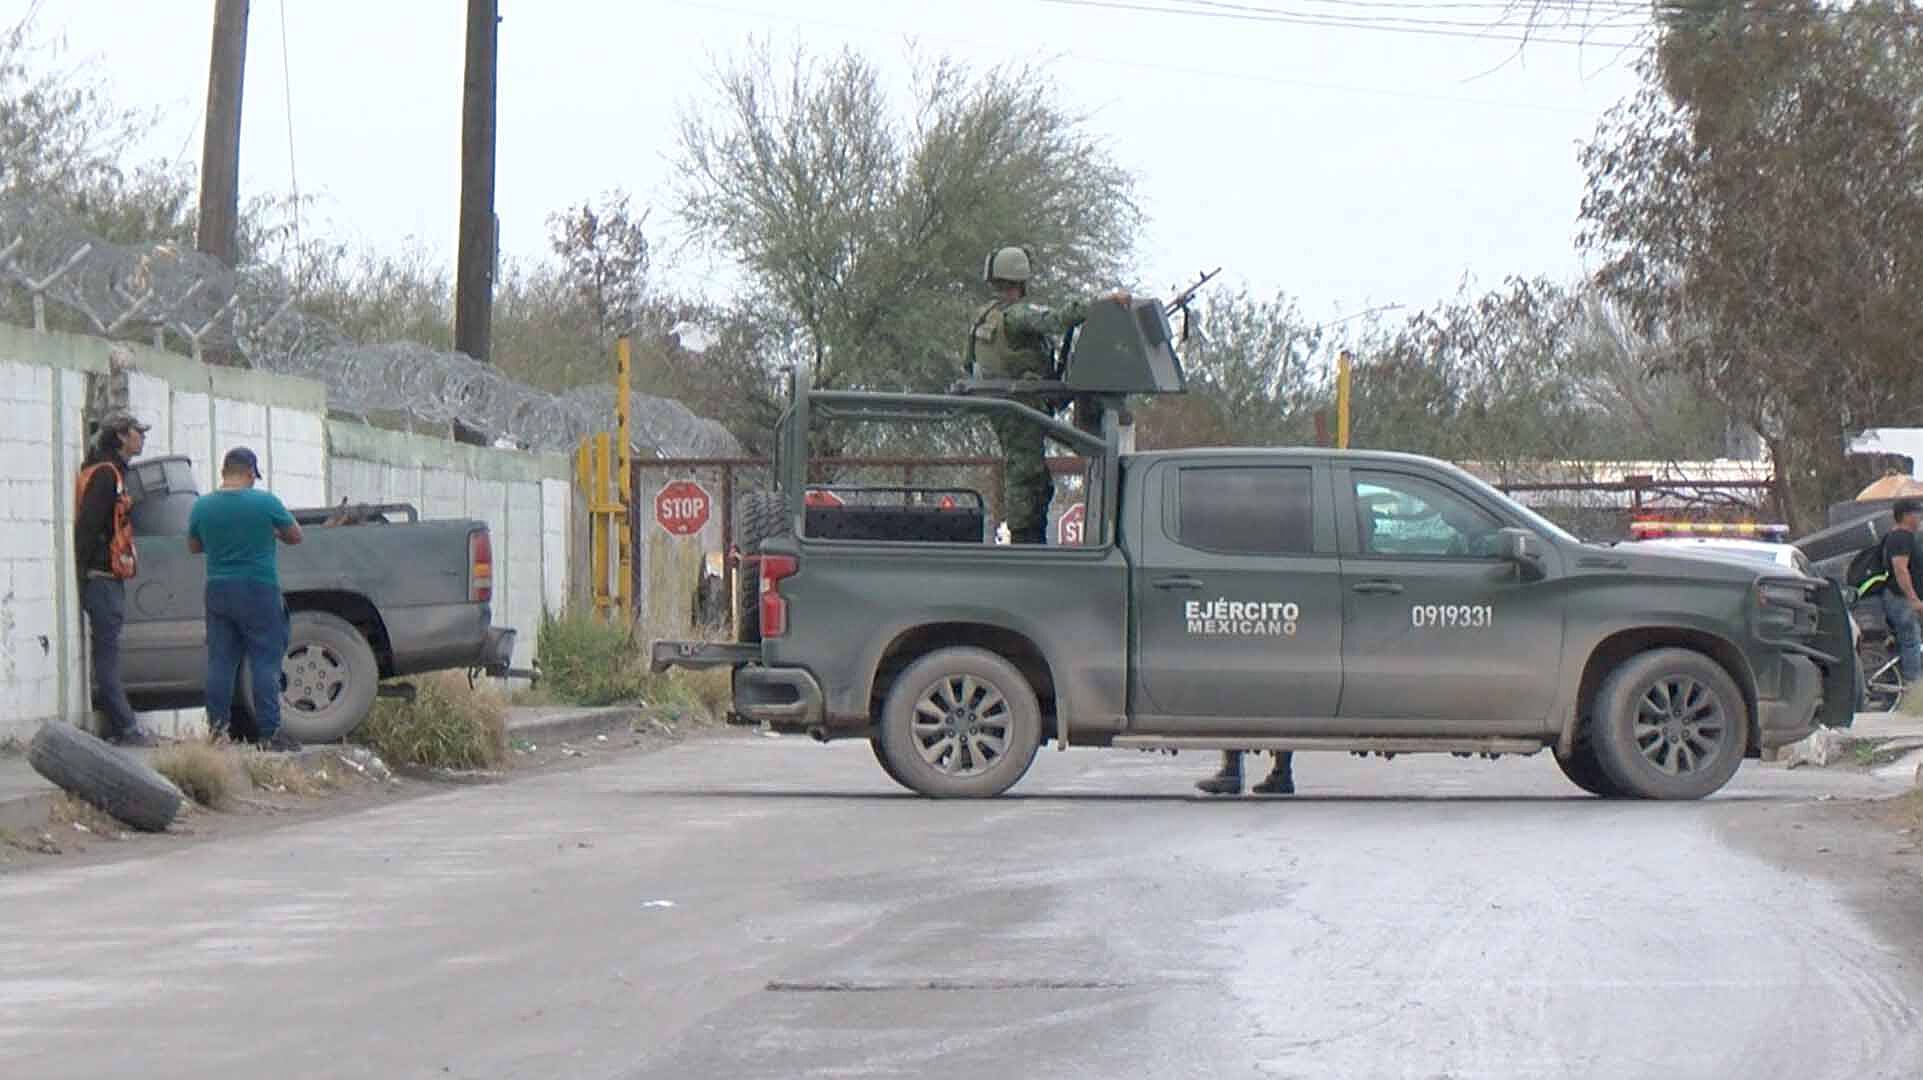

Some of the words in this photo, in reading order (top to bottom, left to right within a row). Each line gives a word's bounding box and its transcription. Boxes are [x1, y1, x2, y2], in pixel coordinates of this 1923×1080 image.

[662, 498, 704, 518] STOP
[1185, 597, 1299, 620] EJÉRCITO
[1412, 605, 1492, 627] 0919331
[1187, 620, 1297, 635] MEXICANO
